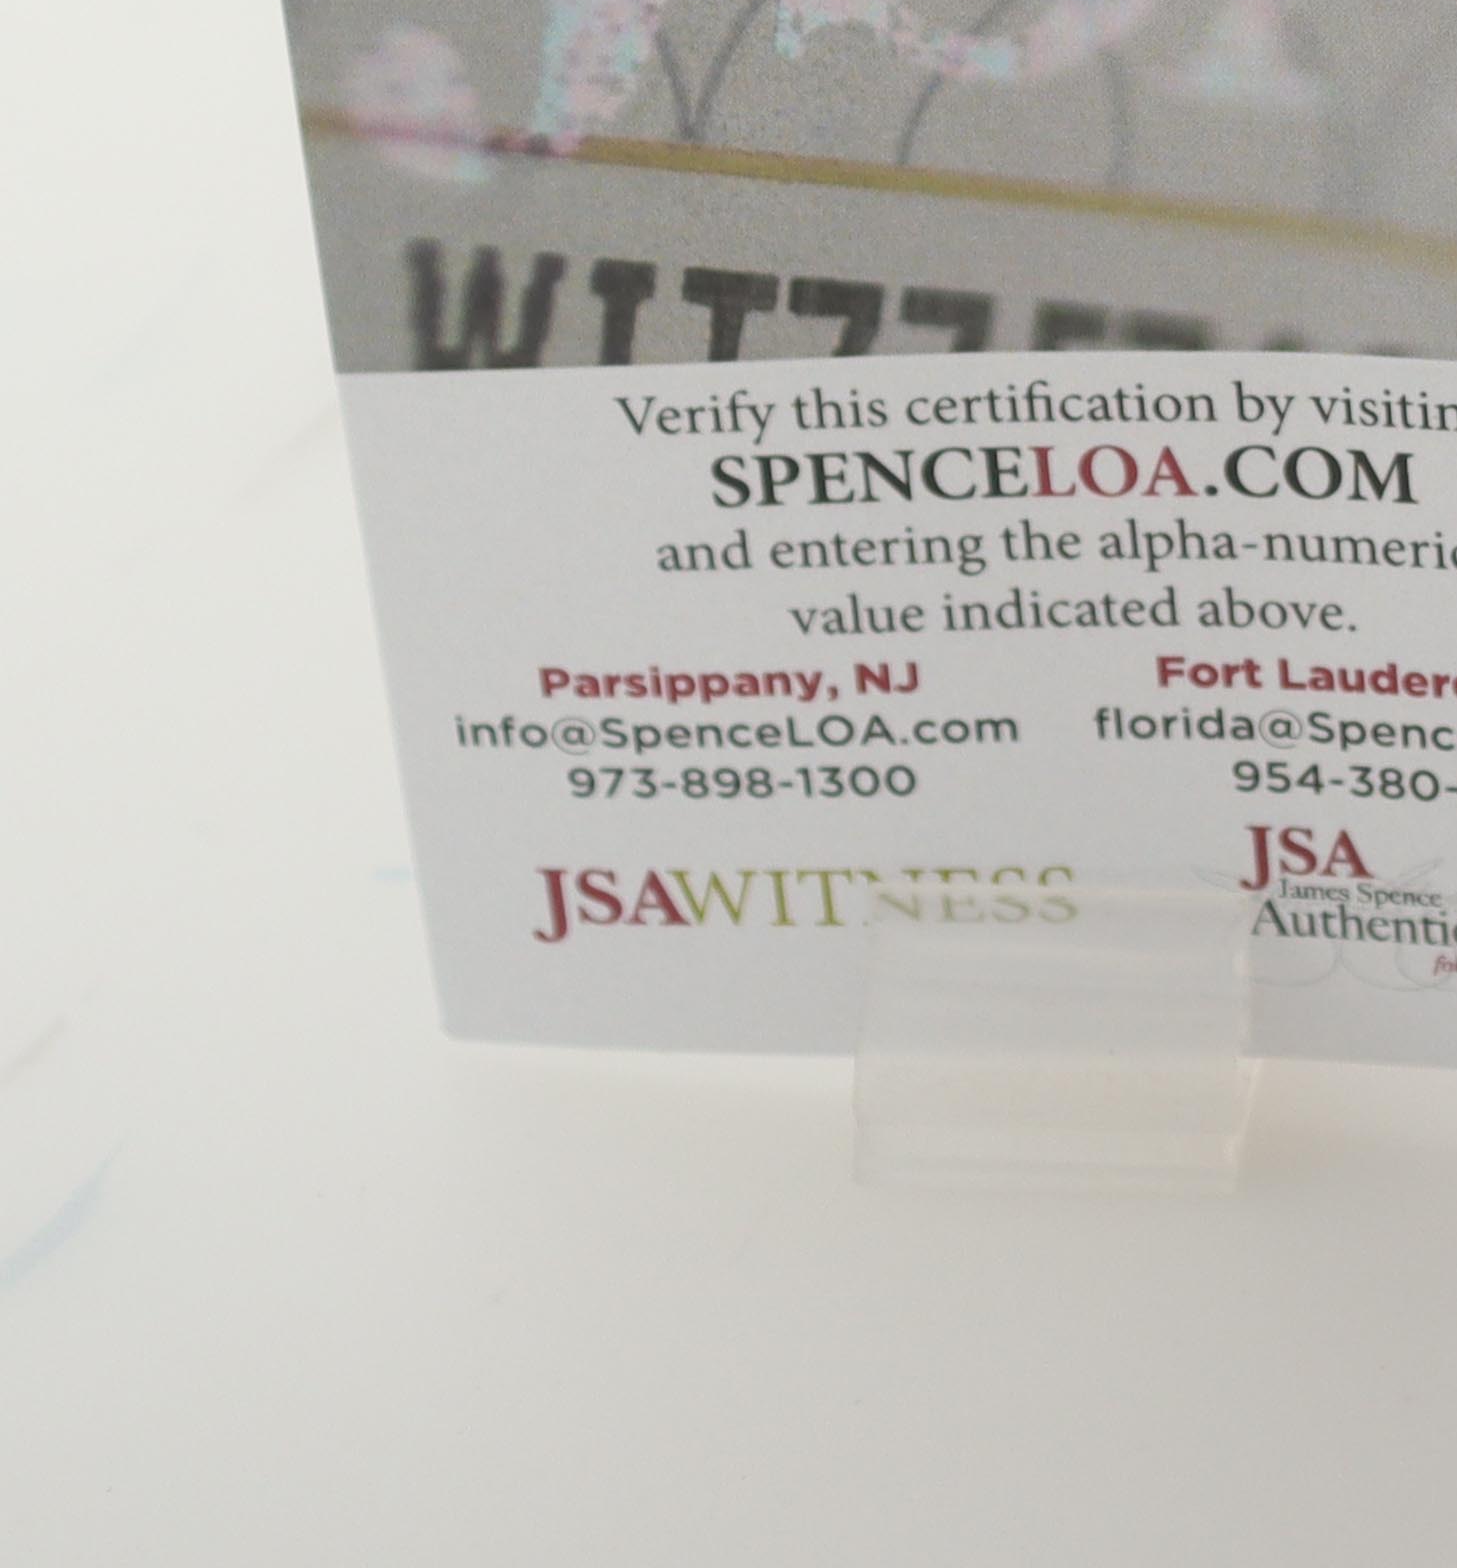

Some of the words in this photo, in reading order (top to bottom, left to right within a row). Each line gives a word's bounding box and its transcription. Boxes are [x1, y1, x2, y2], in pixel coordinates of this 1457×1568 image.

[613, 388, 775, 445] Verify
[793, 387, 888, 430] this
[905, 379, 1217, 427] certification
[1232, 380, 1294, 436] by
[710, 443, 1419, 508] SPENCELOA.COM
[656, 528, 754, 572] and
[769, 526, 988, 577] entering
[1000, 518, 1082, 561] the
[788, 592, 926, 634] value
[942, 586, 1181, 632] indicated
[1198, 586, 1358, 633] above.
[539, 665, 840, 704] Parsippany,
[854, 661, 920, 695] NJ
[1155, 655, 1263, 689] Fort
[455, 714, 1020, 756] info@SpenceLOA.com
[567, 765, 919, 800] 973-898-1300
[1240, 825, 1375, 892] JSA
[1280, 879, 1350, 904] James
[1357, 882, 1443, 912] Spence
